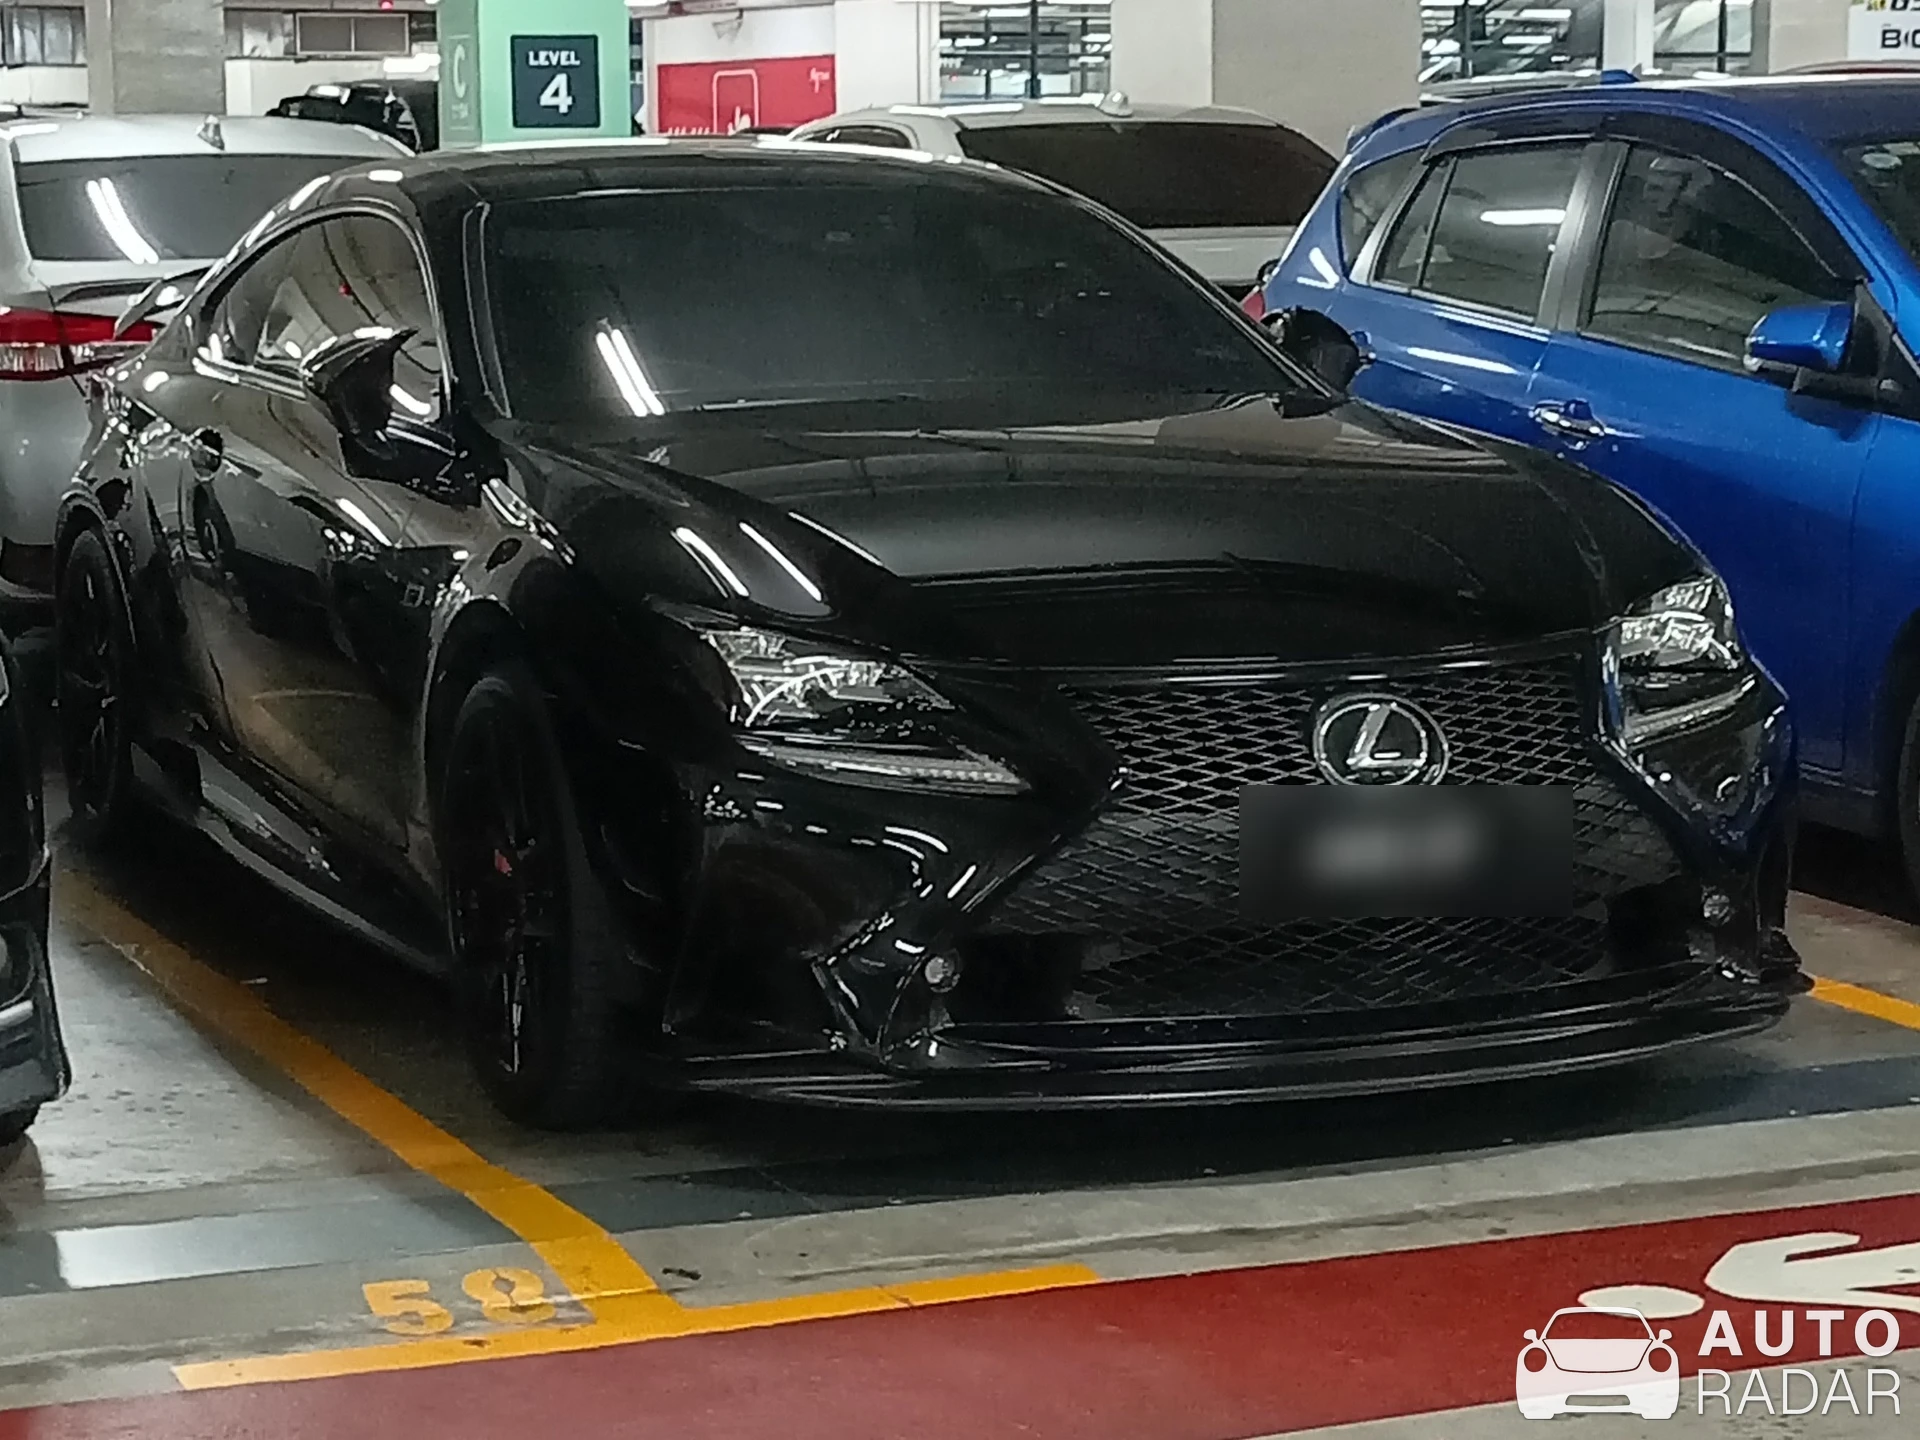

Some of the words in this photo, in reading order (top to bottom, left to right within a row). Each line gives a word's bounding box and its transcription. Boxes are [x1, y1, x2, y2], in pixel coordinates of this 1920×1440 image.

[453, 43, 466, 98] C
[528, 50, 581, 66] LEVEL
[540, 72, 573, 113] 4
[362, 1266, 556, 1335] 58
